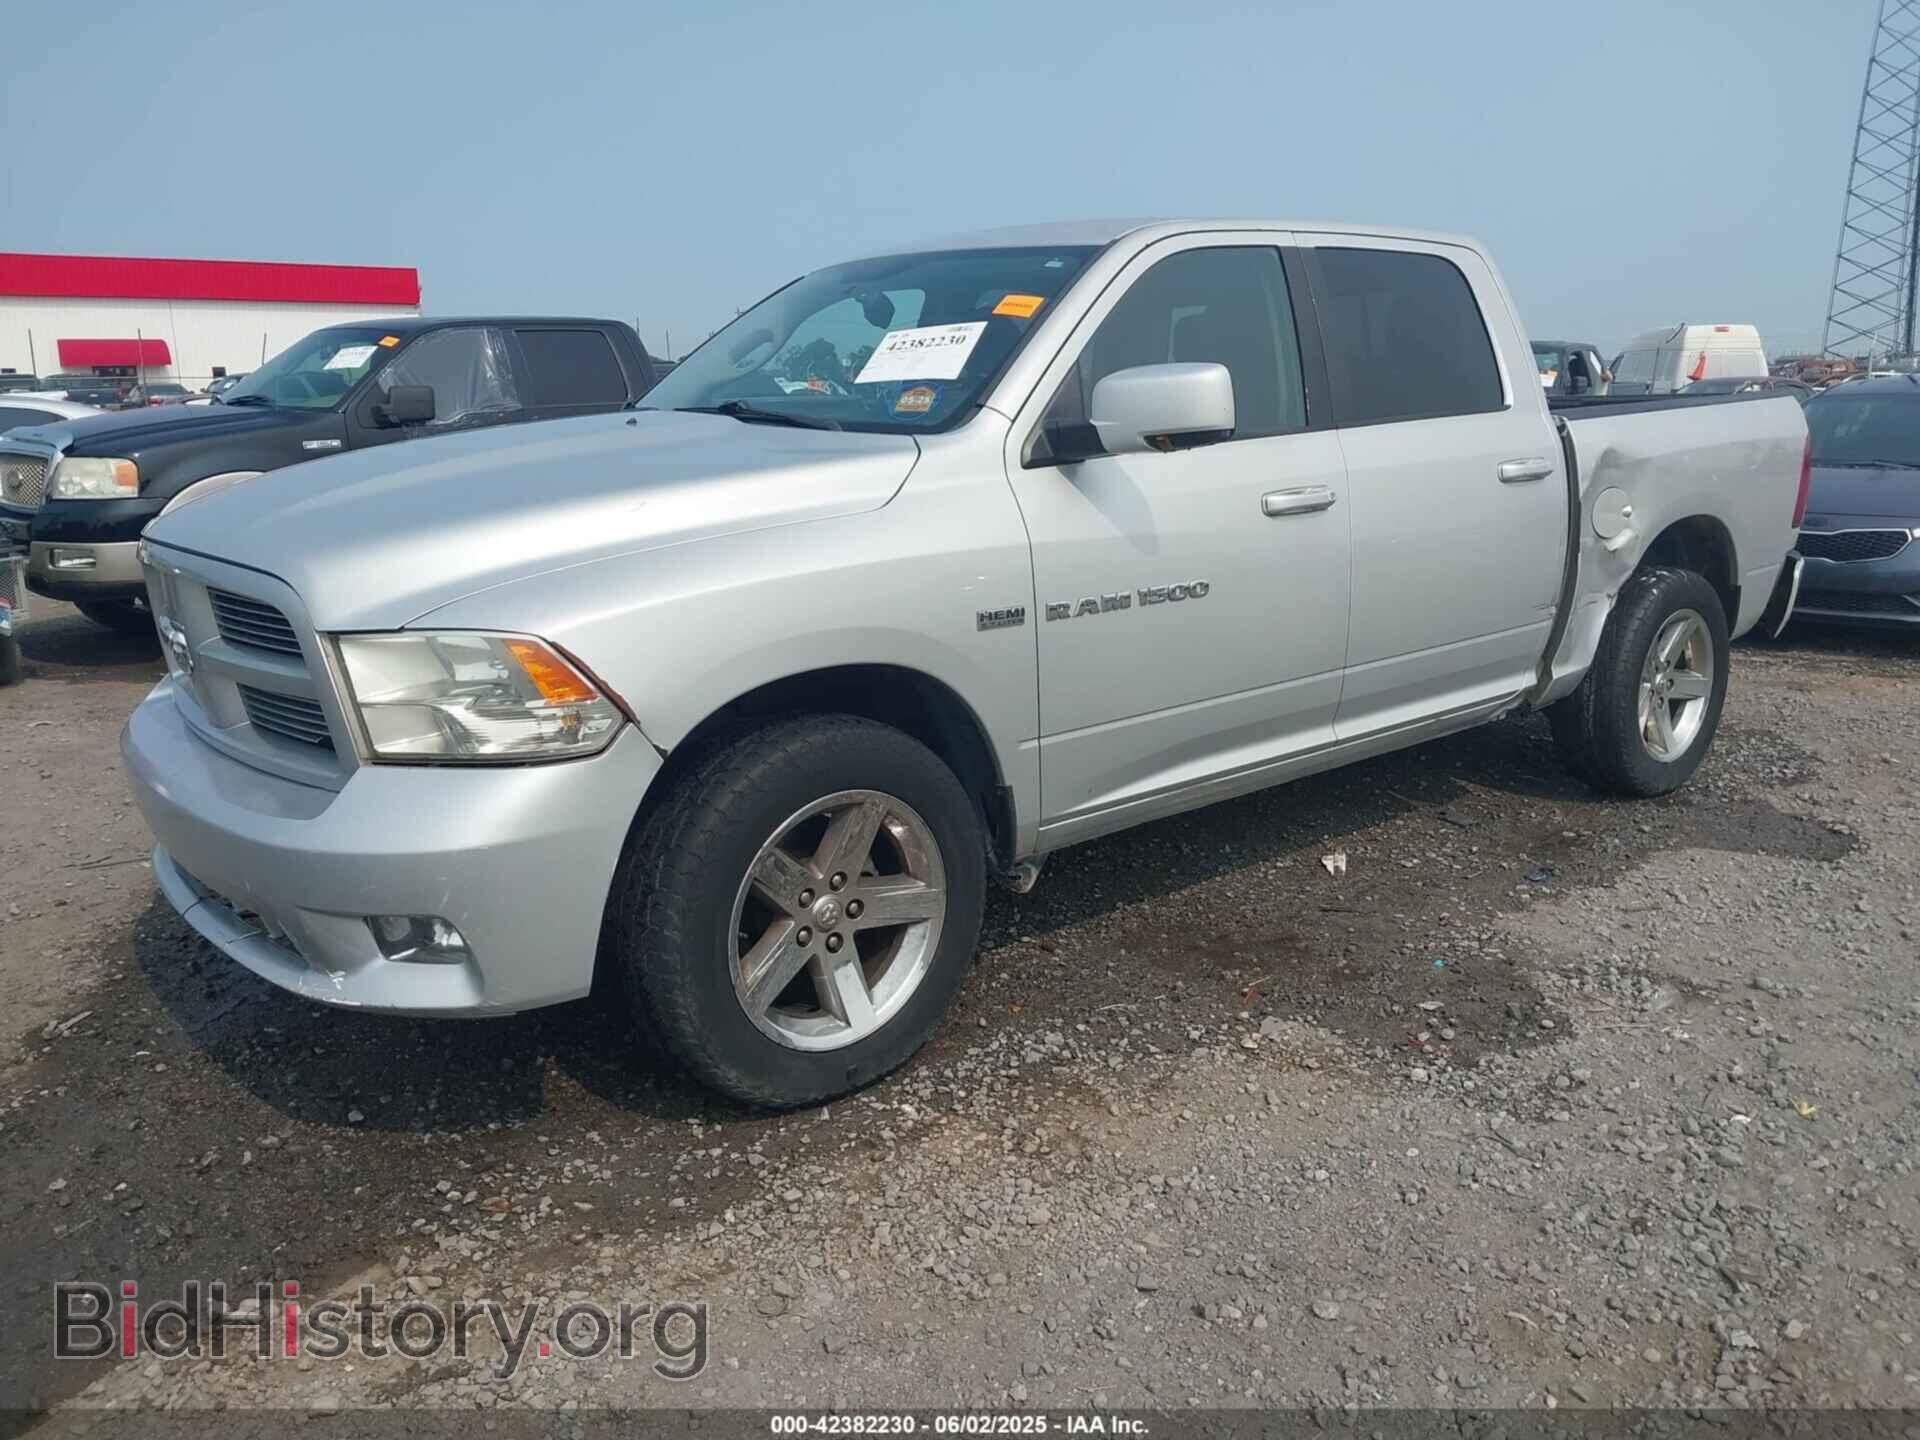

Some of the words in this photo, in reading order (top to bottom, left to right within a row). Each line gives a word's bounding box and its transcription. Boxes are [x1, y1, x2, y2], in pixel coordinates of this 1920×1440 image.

[886, 335, 967, 352] 42382230
[1046, 592, 1132, 622] RAM
[1137, 579, 1210, 606] 1500
[979, 606, 1025, 622] HEMI
